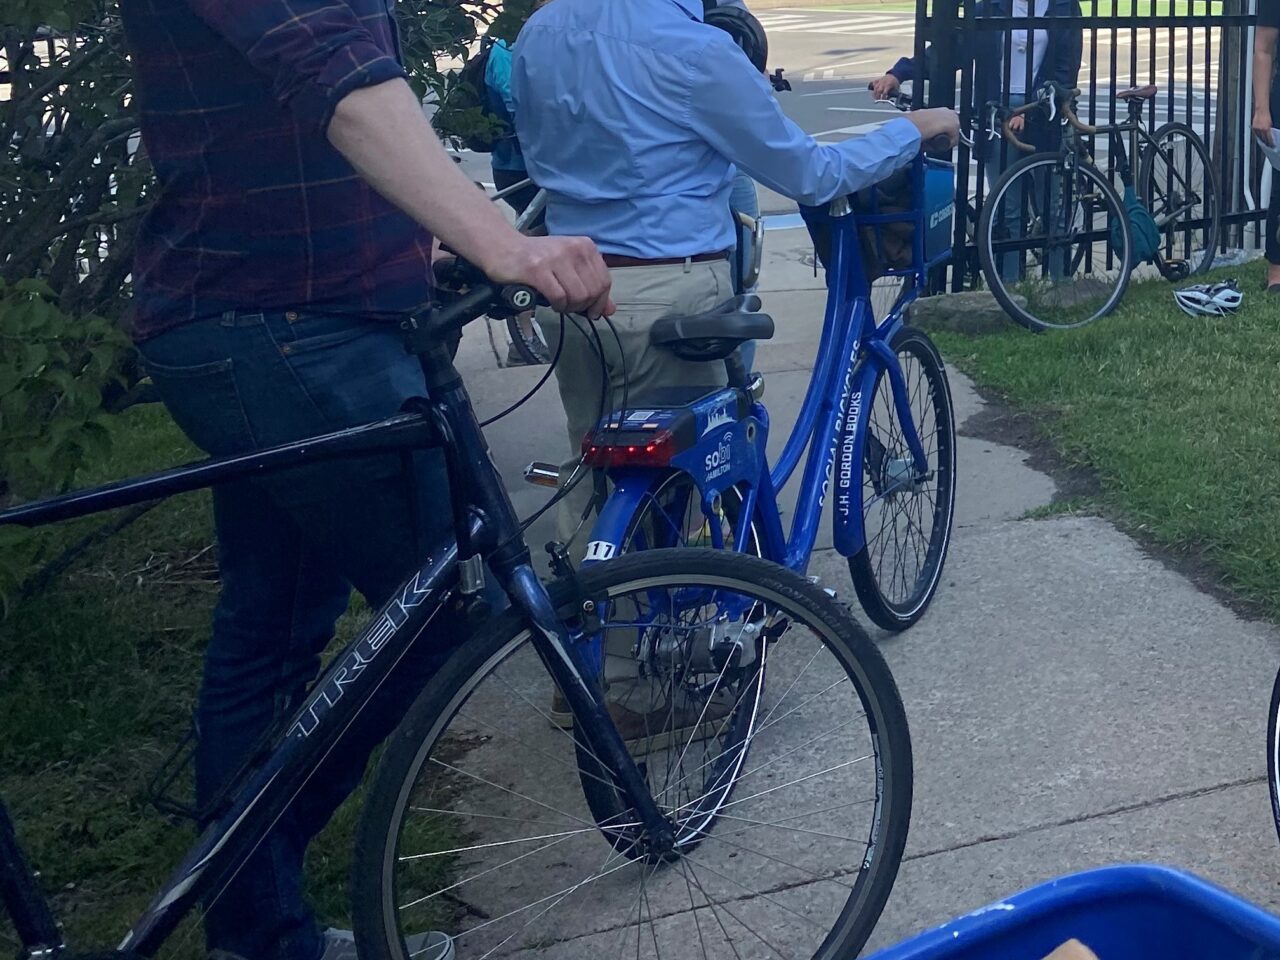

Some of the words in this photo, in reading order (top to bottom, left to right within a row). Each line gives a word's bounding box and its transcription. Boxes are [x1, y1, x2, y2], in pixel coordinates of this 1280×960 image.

[846, 392, 861, 431] BOOKS
[840, 435, 855, 488] GORDON
[285, 570, 432, 739] TREK
